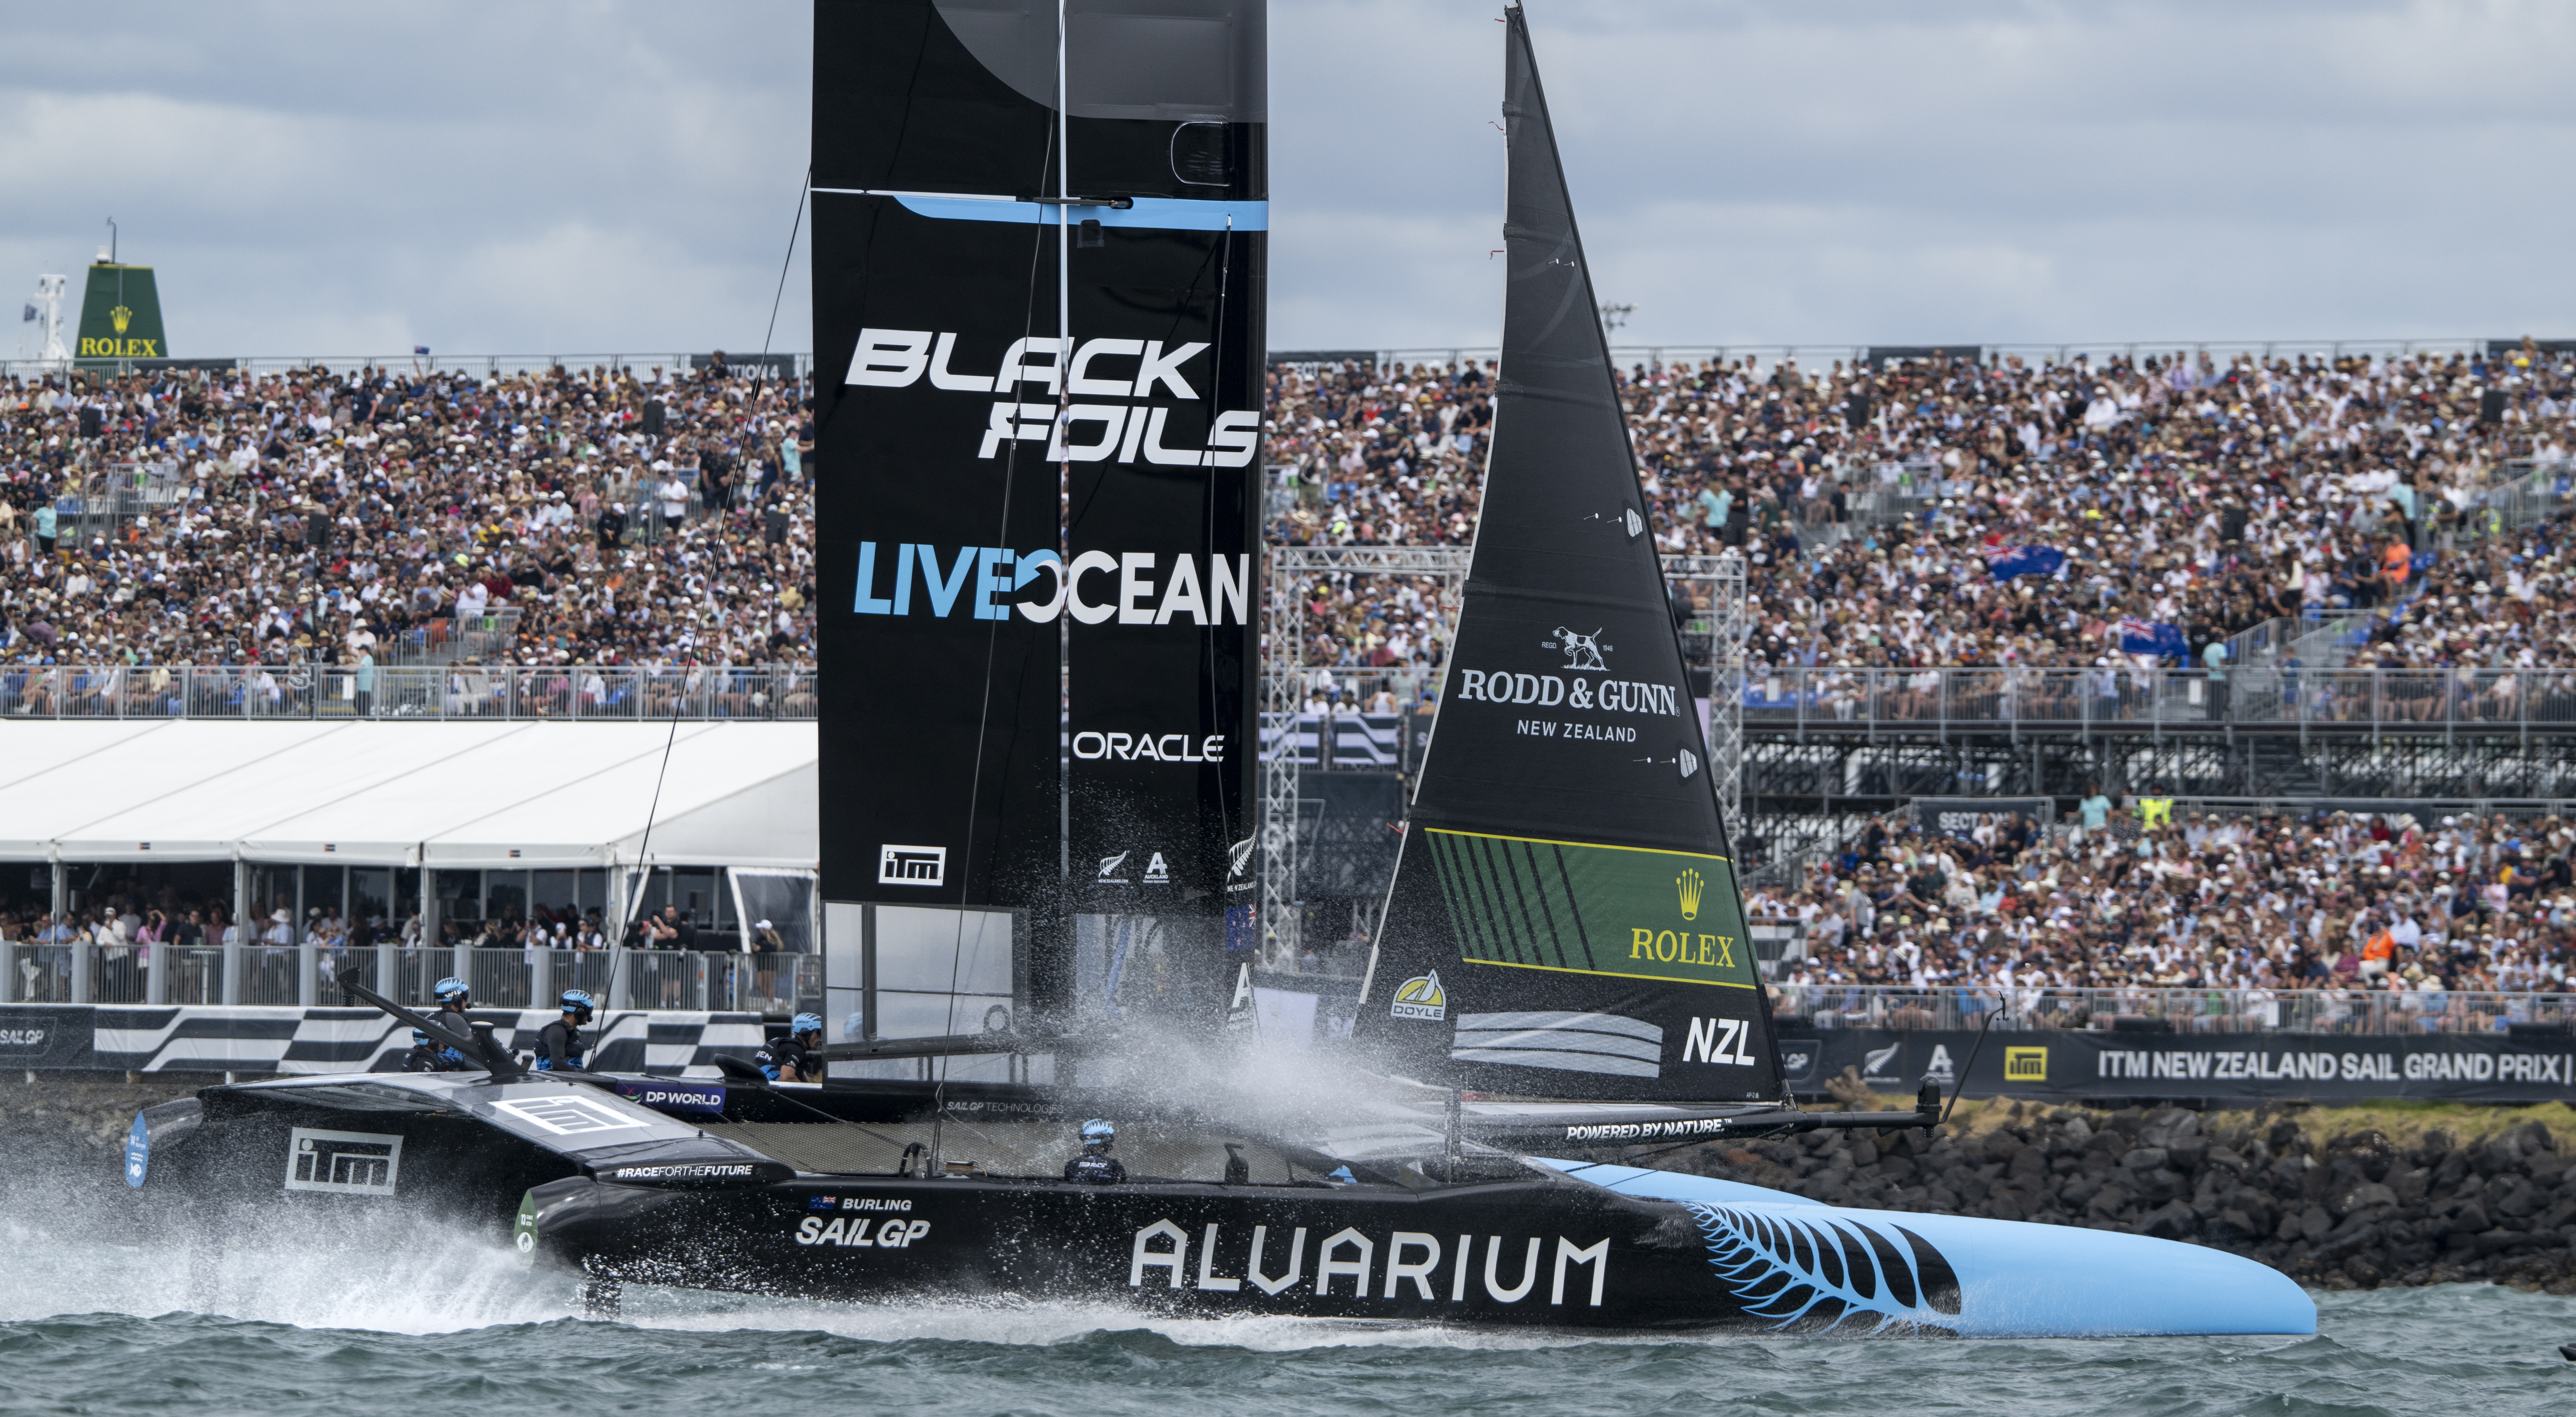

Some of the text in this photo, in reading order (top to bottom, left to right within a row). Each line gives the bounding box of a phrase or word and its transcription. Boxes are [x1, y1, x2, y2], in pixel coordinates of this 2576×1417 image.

[81, 338, 157, 357] ROLEX
[845, 328, 1211, 399] BLACK
[978, 402, 1261, 468] FOILS
[1458, 669, 1565, 706] RODD
[1569, 677, 1594, 709] &
[1517, 720, 1636, 742] NEW ZEALAND
[1073, 731, 1224, 763] ORACLE
[1629, 928, 1735, 968] ROLEX
[1393, 1005, 1442, 1018] DOYLE
[1683, 1016, 1755, 1066] NZL
[2099, 1050, 2148, 1078] ITM
[2152, 1051, 2212, 1078] NEW
[2213, 1051, 2338, 1080] ZEALAND
[2341, 1052, 2400, 1080] SAIL
[2404, 1053, 2493, 1081] GRAND
[2497, 1053, 2560, 1081] PRIX
[646, 1091, 721, 1105] DP WORLD
[986, 1102, 1065, 1114] TECHNOLOGIES
[1565, 1124, 1640, 1140] POWERED
[1640, 1122, 1661, 1137] BY
[617, 1165, 753, 1178] #RACEFORTHEFUTURE
[842, 1198, 912, 1211] BURLING
[521, 1213, 526, 1225] 13
[1129, 1218, 1610, 1306] ALVARIUM
